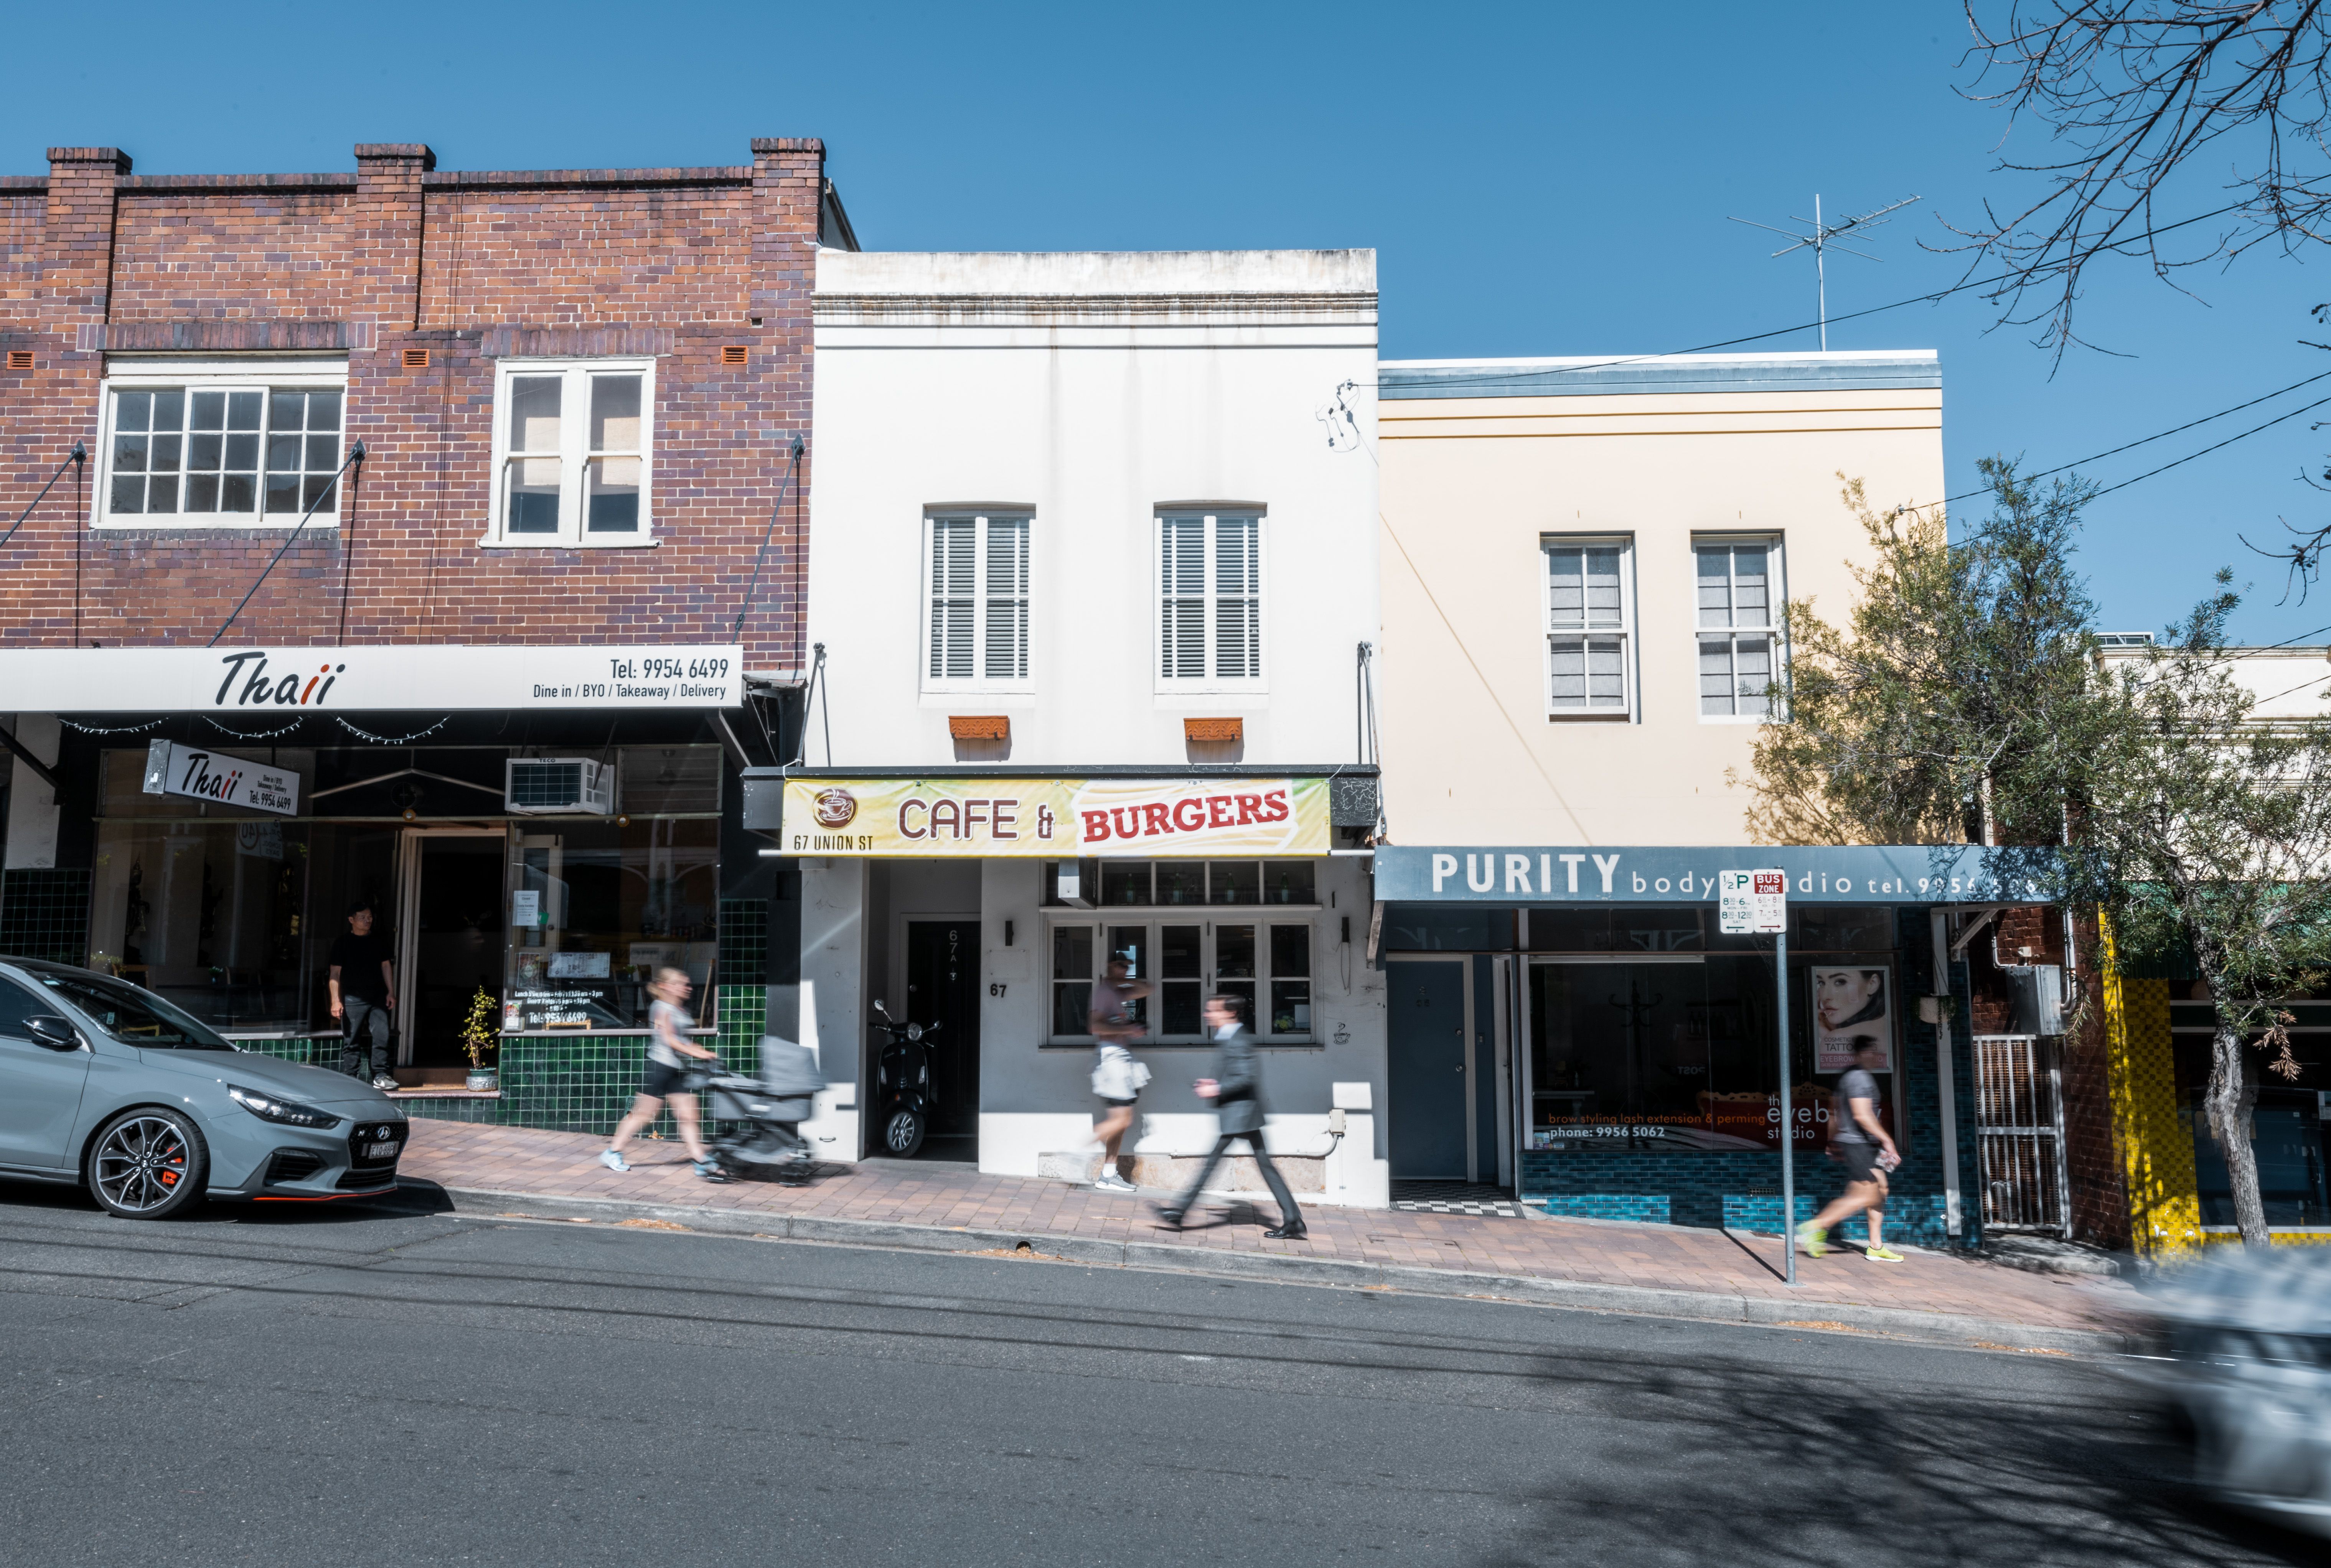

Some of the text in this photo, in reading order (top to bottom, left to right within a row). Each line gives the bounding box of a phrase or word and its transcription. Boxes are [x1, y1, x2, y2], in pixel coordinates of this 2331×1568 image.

[611, 659, 728, 678] Tel: 9954 6499
[216, 652, 345, 705] Thaii
[534, 684, 558, 697] Dine
[562, 684, 572, 697] in
[583, 684, 605, 697] BYO
[617, 684, 669, 700] Takeaway
[681, 684, 726, 700] Delivery
[182, 753, 242, 800] Thaii
[257, 781, 272, 791] Takeaway
[274, 785, 287, 794] Delivery
[250, 790, 291, 810] Tel: 9954 6499
[898, 798, 1054, 840] CAFE &
[1081, 789, 1289, 843] BURGERS
[794, 835, 873, 850] 67 UNION ST
[1432, 854, 1621, 893] PURITY
[1632, 871, 1715, 899] body
[1918, 877, 1976, 894] 9956
[1756, 875, 1780, 884] BUS
[1758, 885, 1779, 893] ZONE
[990, 983, 1007, 998] 67
[1768, 1094, 1779, 1106] th
[1549, 1113, 1765, 1126] brow styling lash extension & perming
[1550, 1127, 1665, 1140] phone: 9956 5062
[1767, 1125, 1815, 1139] stdio
